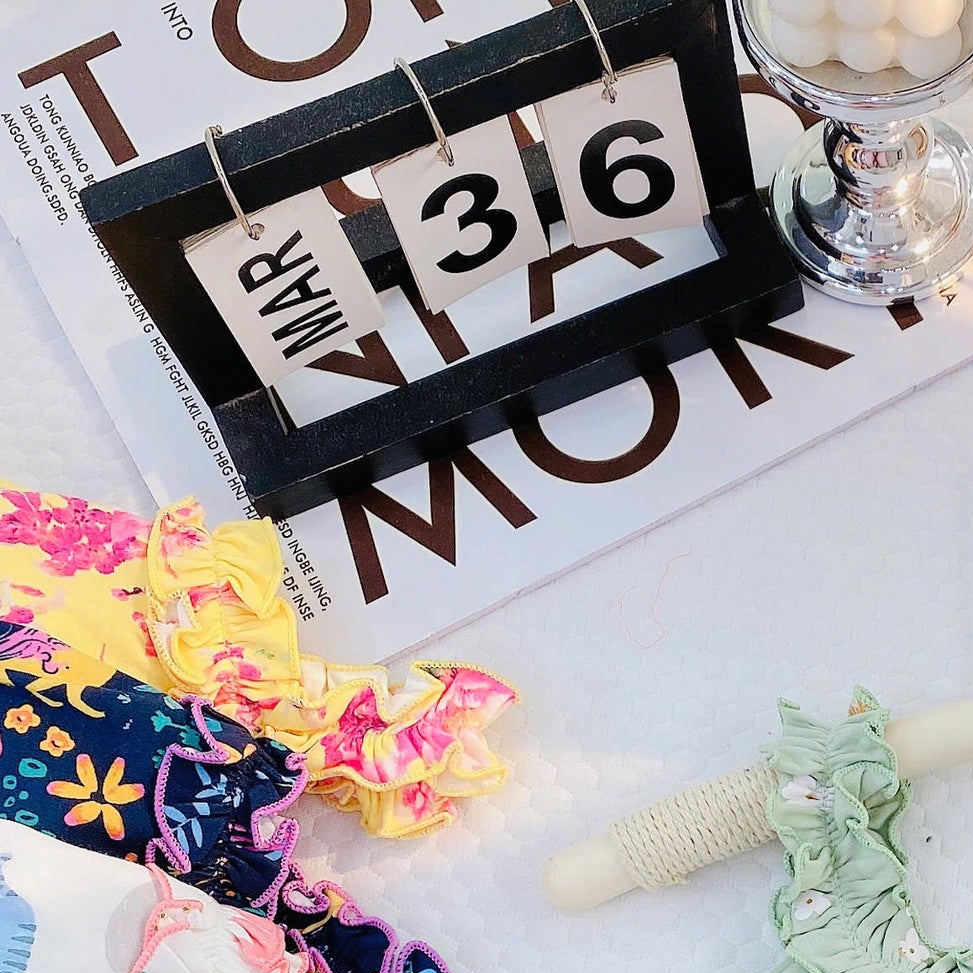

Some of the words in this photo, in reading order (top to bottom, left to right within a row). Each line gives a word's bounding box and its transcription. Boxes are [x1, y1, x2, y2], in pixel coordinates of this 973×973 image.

[160, 2, 193, 41] INTO
[1, 113, 31, 158] ANGOUA
[421, 173, 518, 274] 3
[579, 119, 676, 219] 6
[20, 104, 49, 144] JDKLDIN
[44, 145, 66, 174] GSAH
[60, 174, 80, 199] ONG
[125, 293, 149, 322] ASLIN
[150, 337, 171, 365] HGM
[165, 364, 189, 393] FGHT
[197, 420, 218, 450] GKSD
[213, 450, 233, 476] HBG
[283, 576, 299, 592] DF
[292, 594, 315, 621] INSE
[39, 94, 62, 125] TONG
[55, 125, 88, 173] KUNNIAO
[287, 539, 314, 575] INGBE
[308, 576, 331, 611] IJING,
[238, 230, 349, 360] MAR
